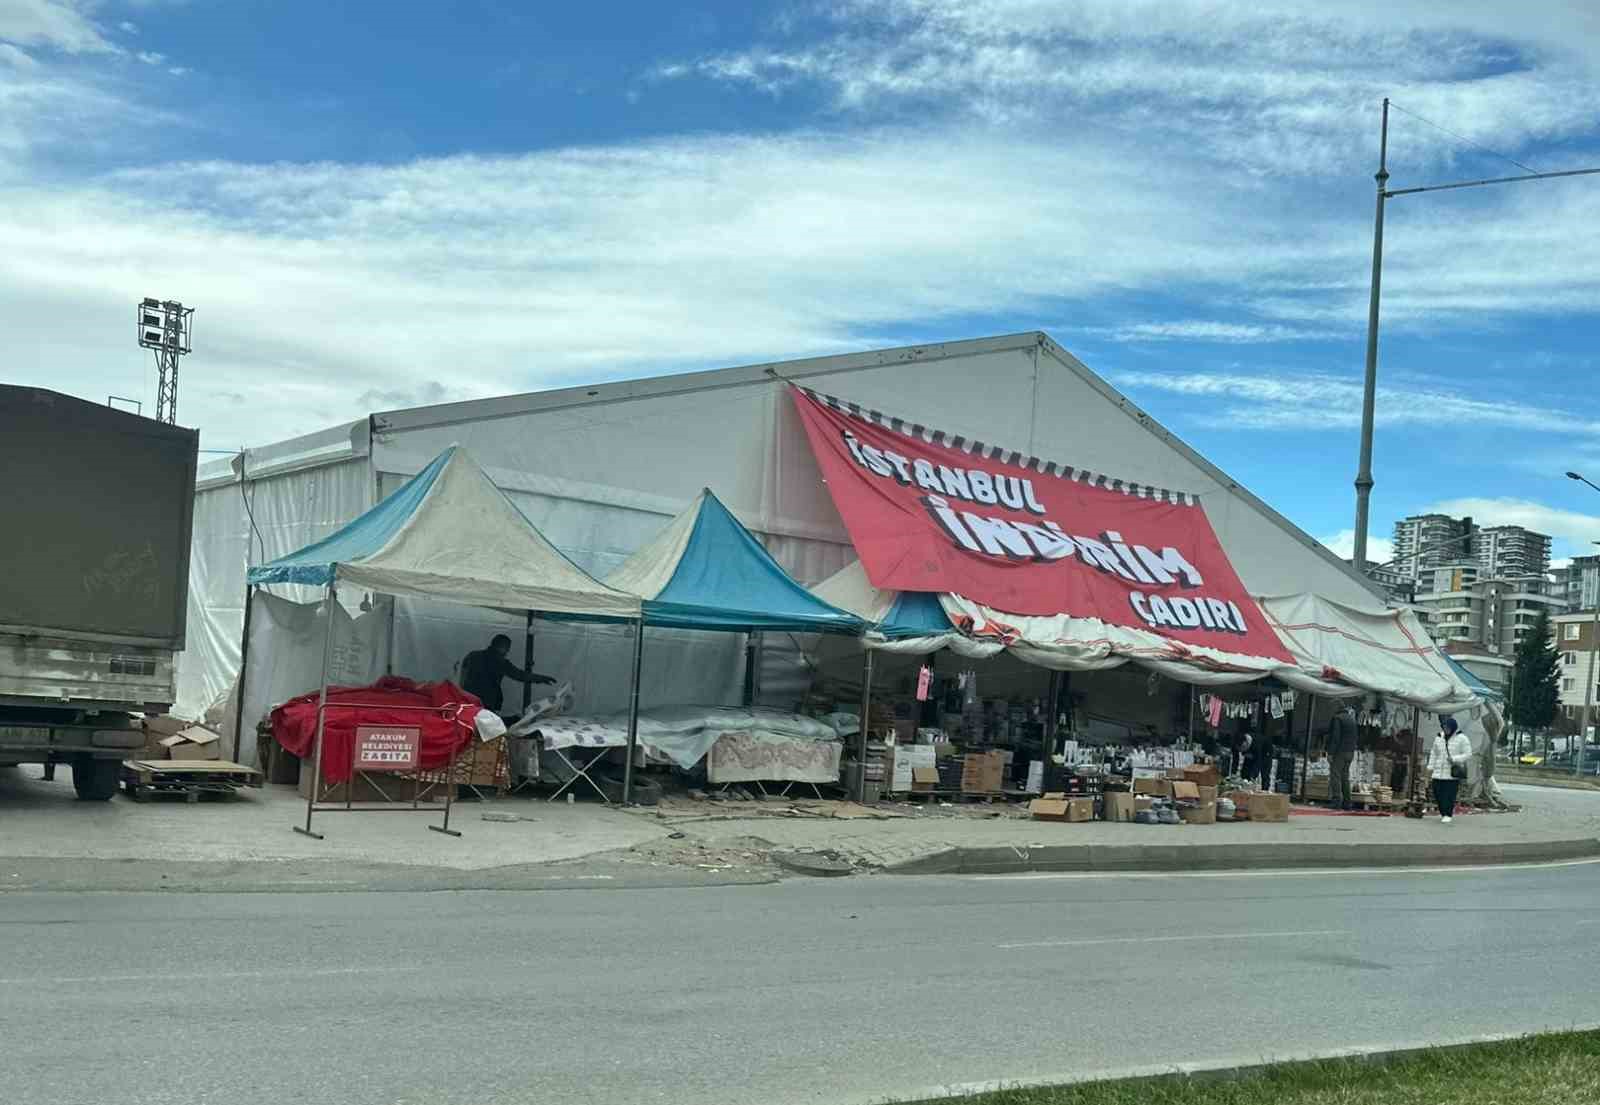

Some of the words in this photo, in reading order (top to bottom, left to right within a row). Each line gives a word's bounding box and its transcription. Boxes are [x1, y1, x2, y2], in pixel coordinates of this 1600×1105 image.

[844, 430, 1046, 514] İSTANBUL
[1130, 591, 1248, 634] ÇADIRI
[369, 733, 407, 741] ATAKUM
